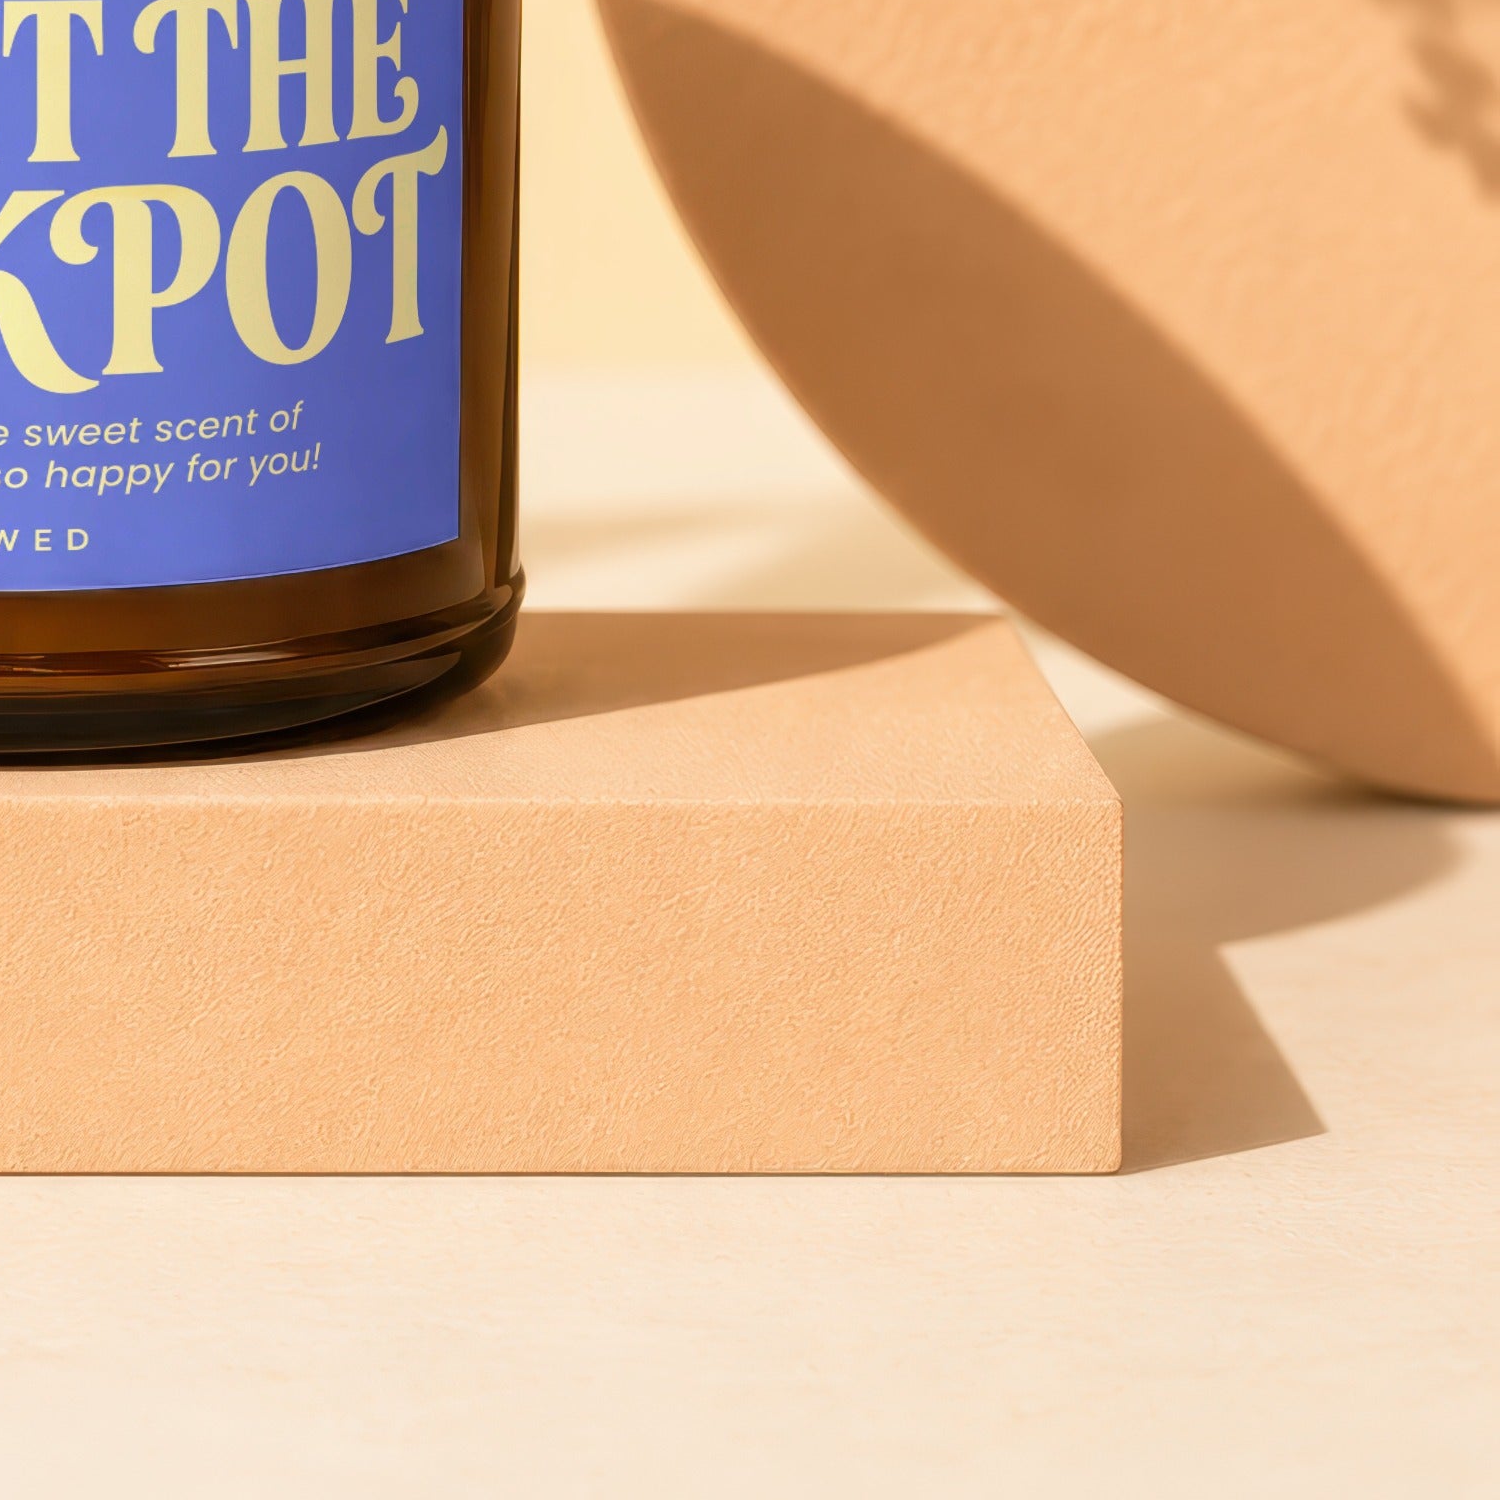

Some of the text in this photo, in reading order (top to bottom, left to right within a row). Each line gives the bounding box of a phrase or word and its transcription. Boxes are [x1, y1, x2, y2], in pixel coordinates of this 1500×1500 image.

[22, 416, 144, 448] sweet
[153, 407, 260, 445] scent
[268, 399, 306, 435] of
[43, 458, 176, 497] happy
[186, 451, 240, 484] for
[247, 440, 323, 488] you!
